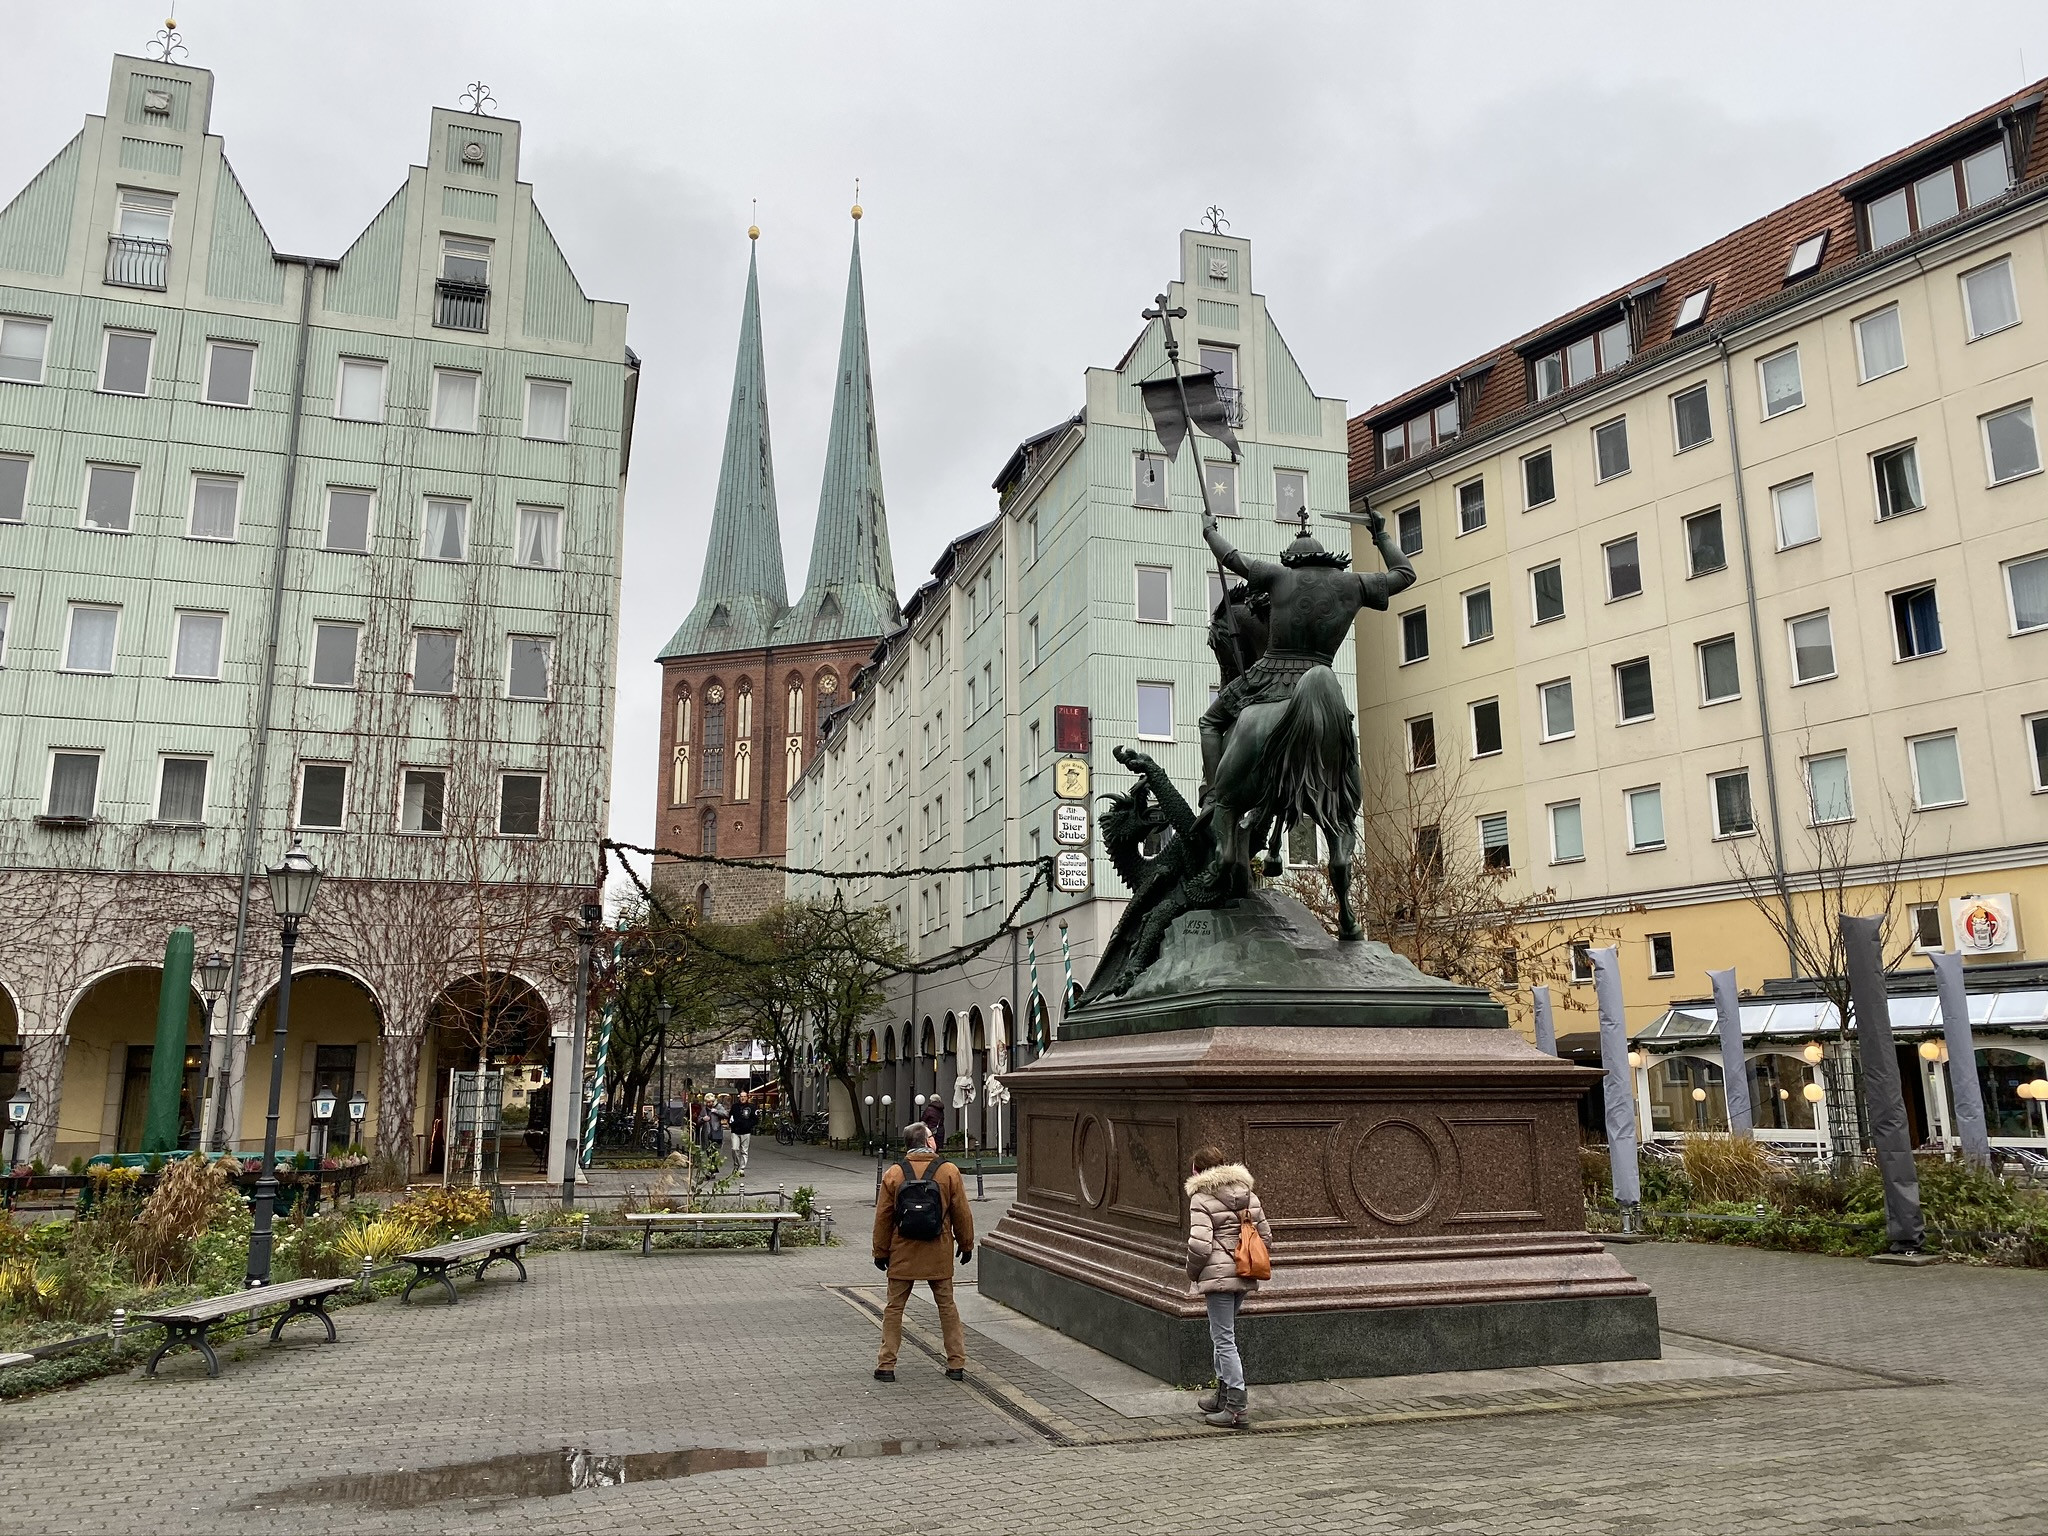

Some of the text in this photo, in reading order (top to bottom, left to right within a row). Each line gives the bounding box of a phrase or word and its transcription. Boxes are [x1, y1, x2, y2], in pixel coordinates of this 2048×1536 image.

[1062, 822, 1083, 831] Bier
[1058, 830, 1086, 839] Stube
[1059, 867, 1087, 877] Spree
[1061, 877, 1086, 886] Blick
[1188, 920, 1208, 929] KISS
